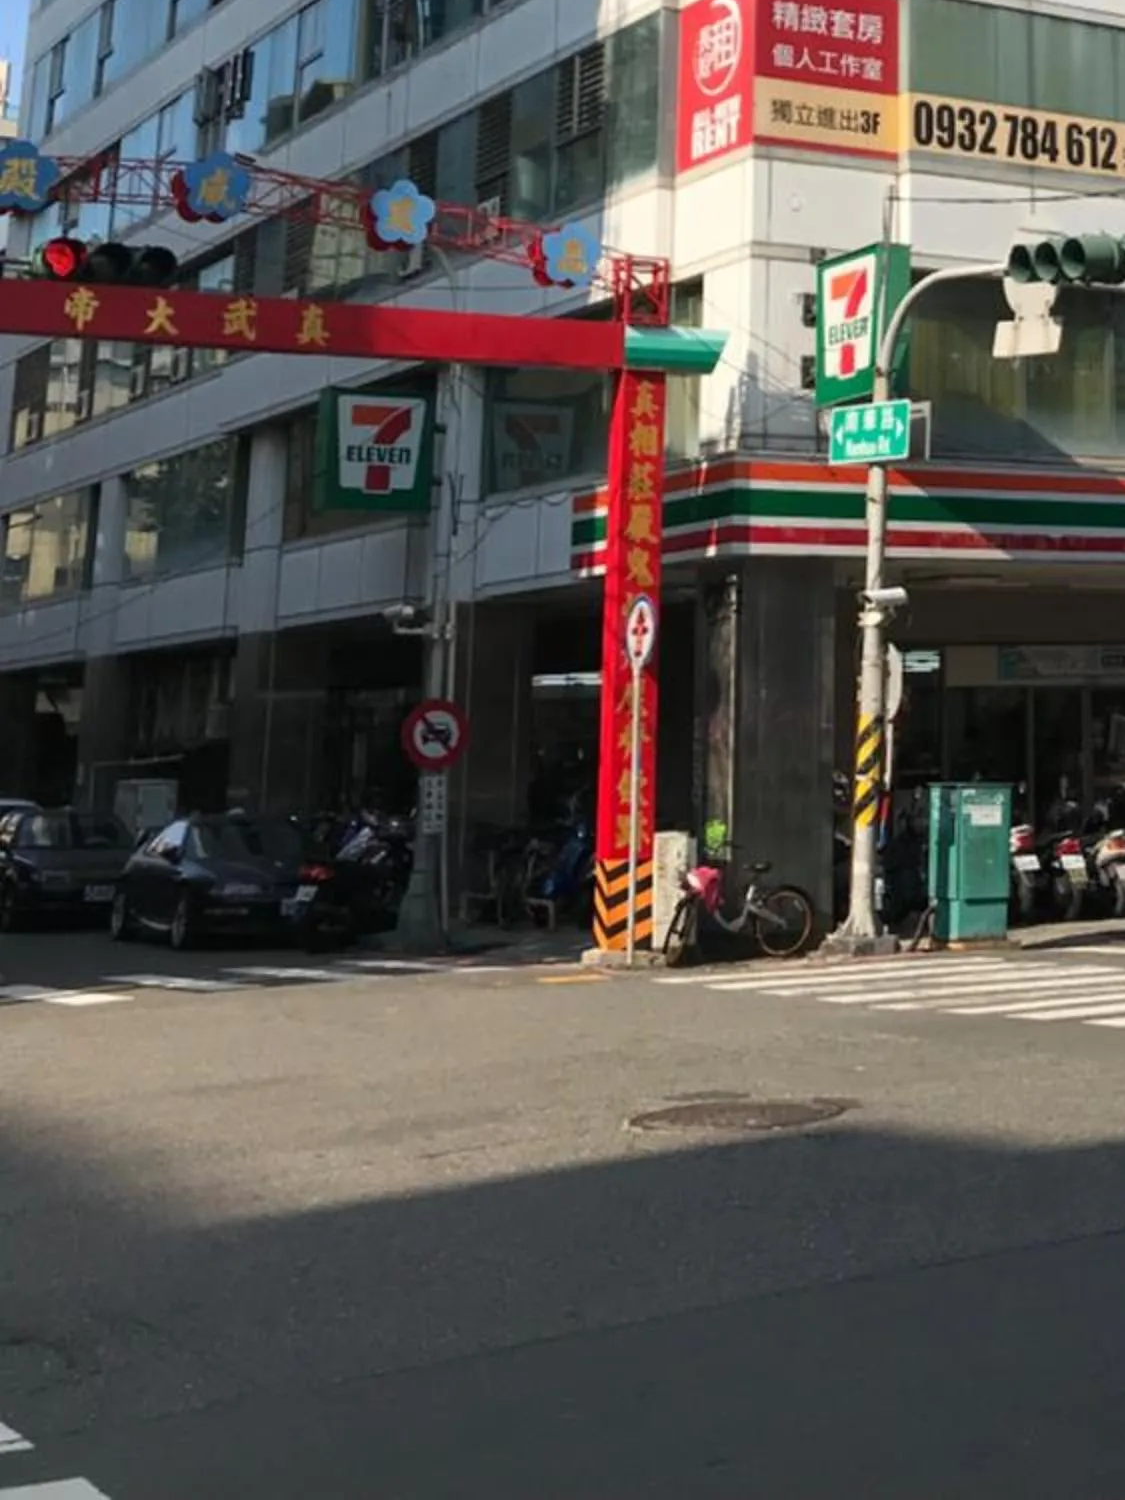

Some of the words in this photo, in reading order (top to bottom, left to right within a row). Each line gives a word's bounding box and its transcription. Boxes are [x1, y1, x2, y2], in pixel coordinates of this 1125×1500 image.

[772, 0, 884, 44] 精緻套房
[772, 43, 884, 82] 個人工作室
[913, 100, 997, 154] 0932
[1003, 114, 1060, 164] 784
[1066, 122, 1117, 171] 612
